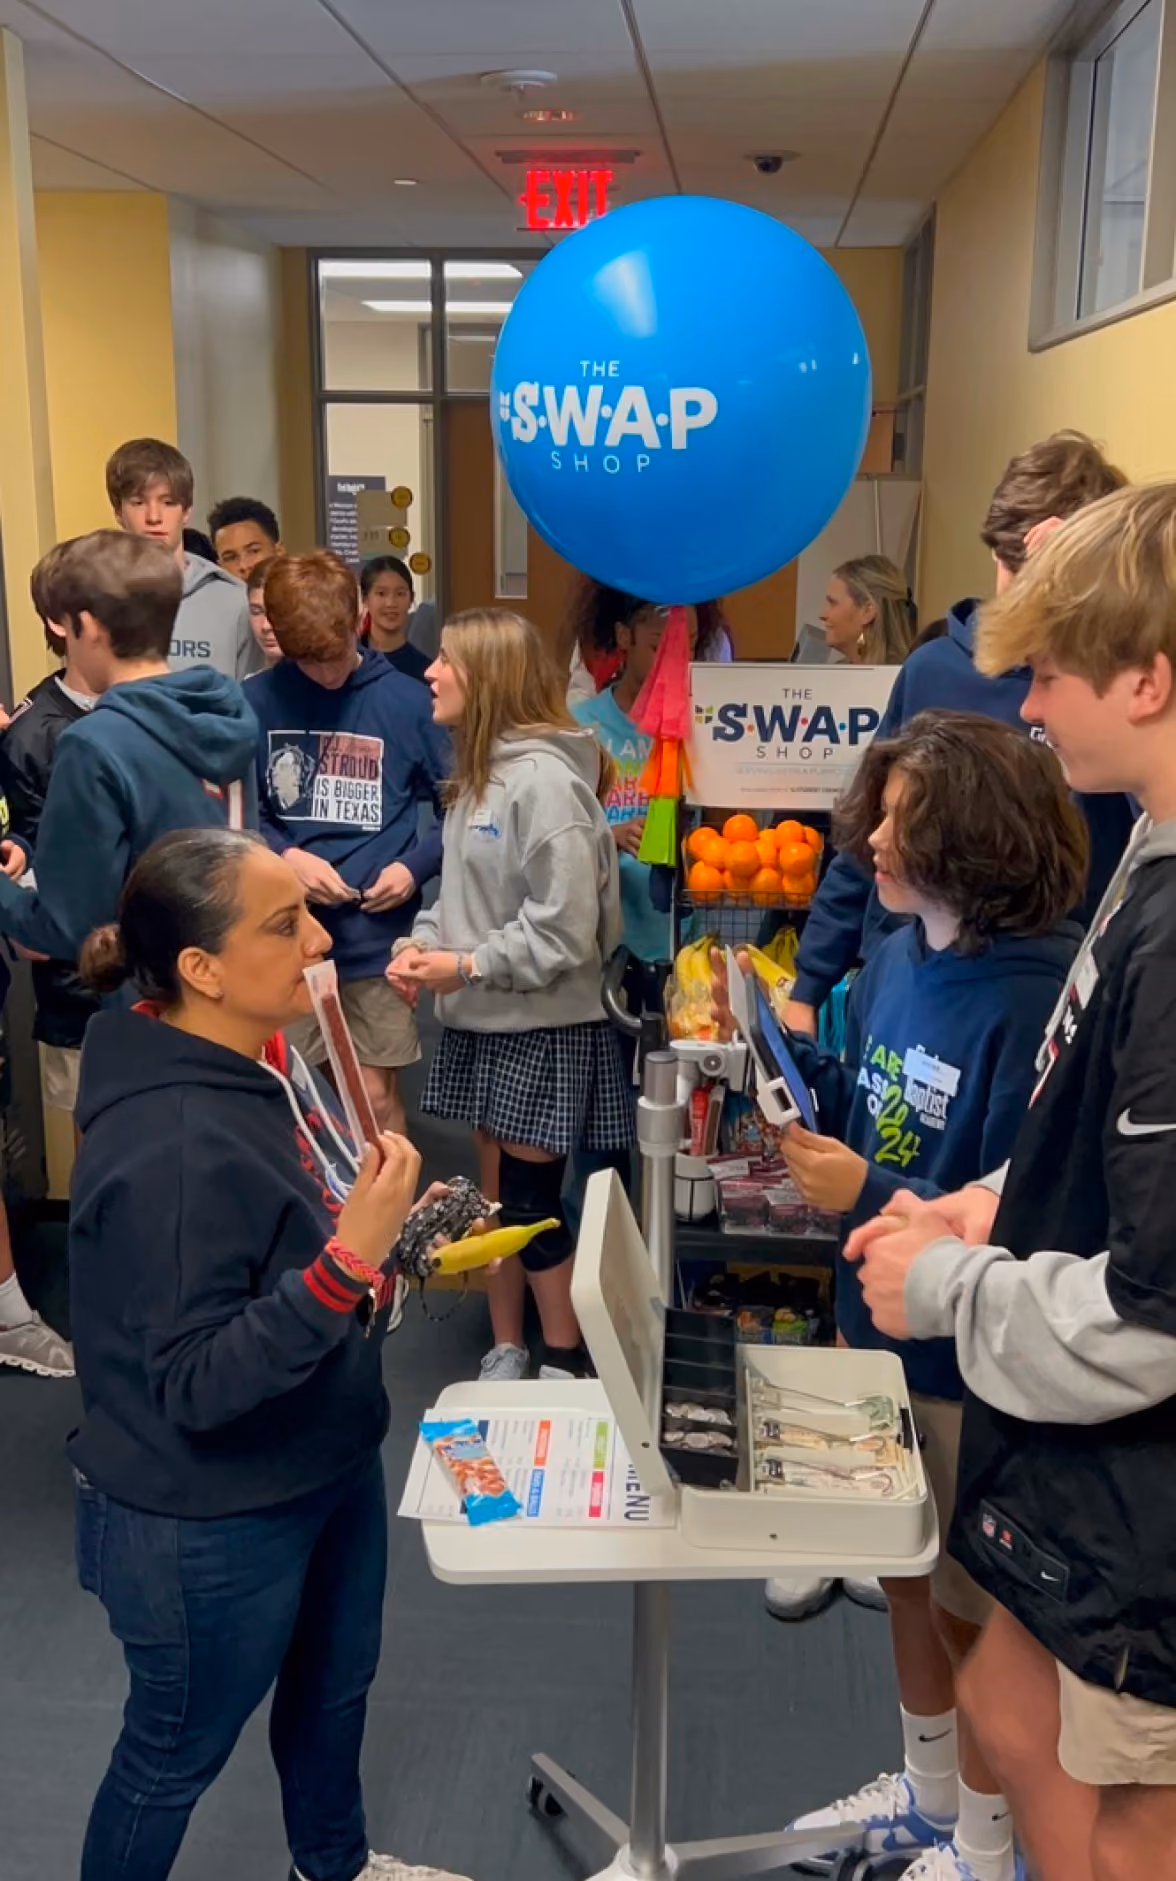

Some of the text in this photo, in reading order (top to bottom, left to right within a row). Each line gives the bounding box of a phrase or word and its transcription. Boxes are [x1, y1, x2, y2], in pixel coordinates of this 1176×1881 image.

[525, 169, 613, 229] EXIT
[579, 359, 620, 377] THE
[551, 450, 651, 474] SHOP
[782, 687, 813, 701] THE
[756, 746, 834, 760] SHOP
[319, 753, 379, 780] STROUD
[315, 778, 379, 802] IS BIGGER
[314, 798, 379, 823] IN TEXAS
